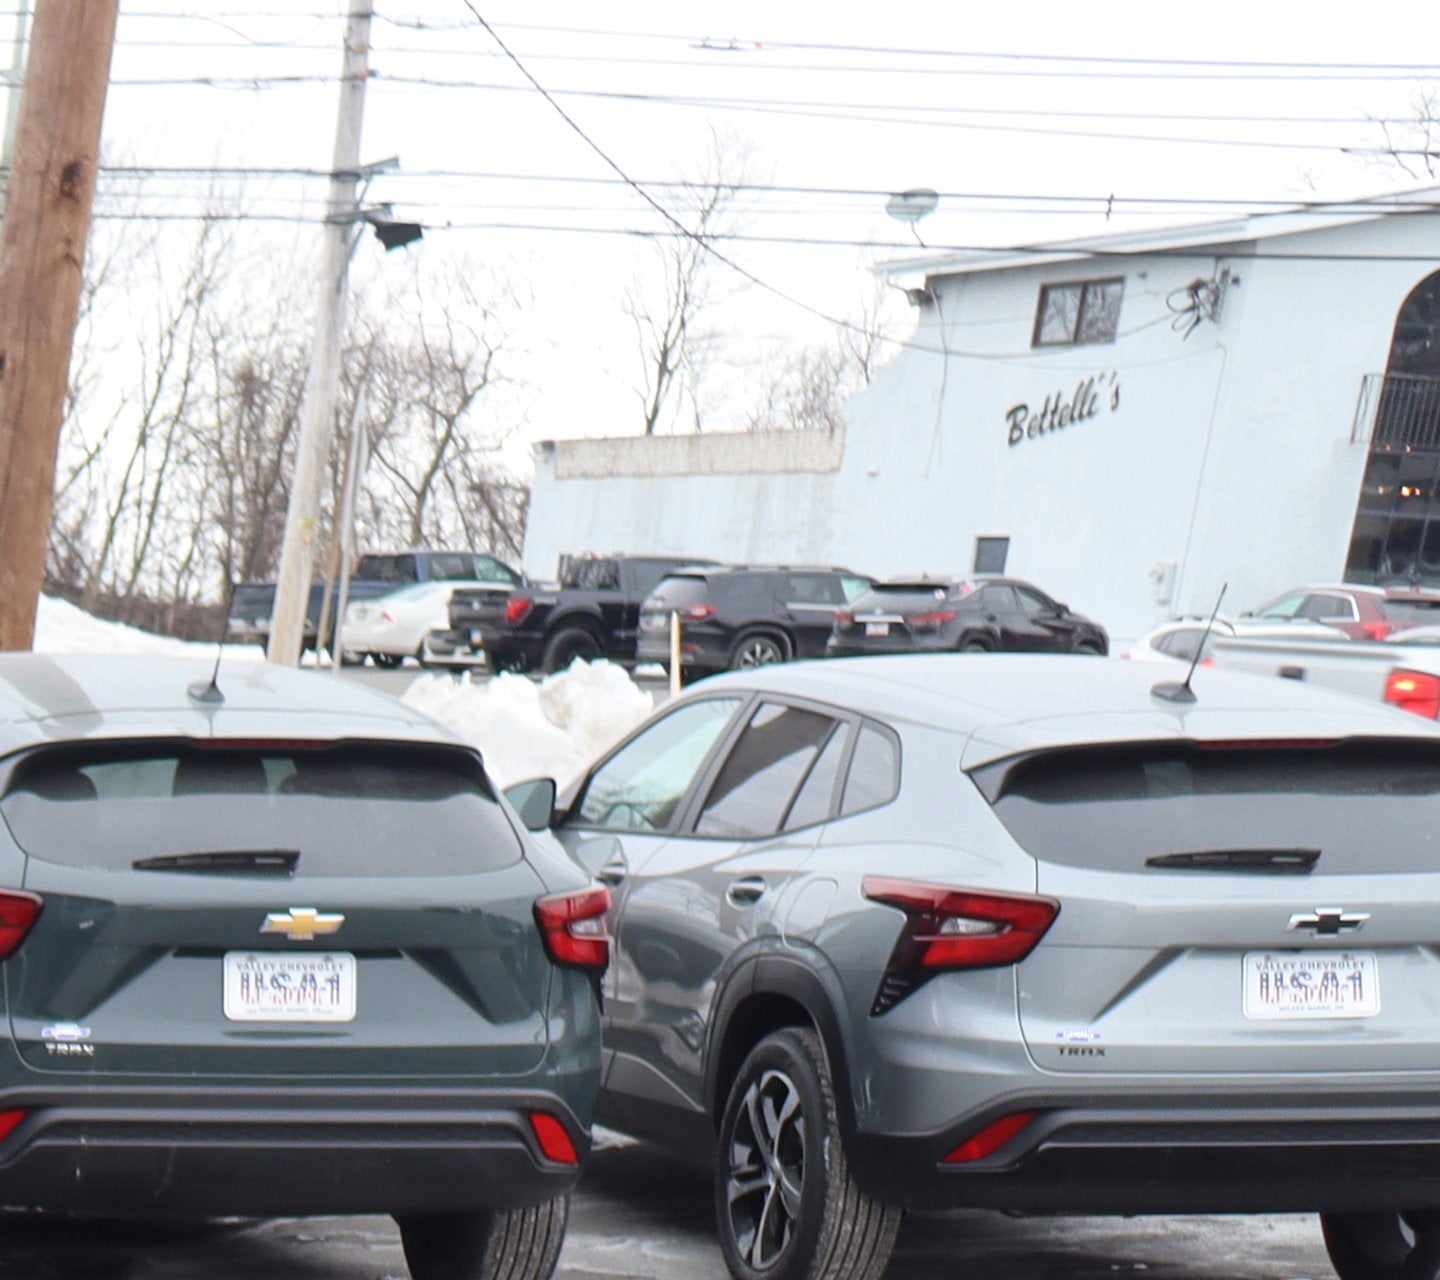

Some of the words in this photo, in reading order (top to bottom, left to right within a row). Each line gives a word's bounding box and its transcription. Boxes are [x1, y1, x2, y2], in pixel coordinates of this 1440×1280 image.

[1255, 961, 1296, 971] VALLEY
[1300, 960, 1366, 970] CHEVROLET
[45, 1042, 94, 1056] TRAX
[1058, 1046, 1106, 1057] TRAX
